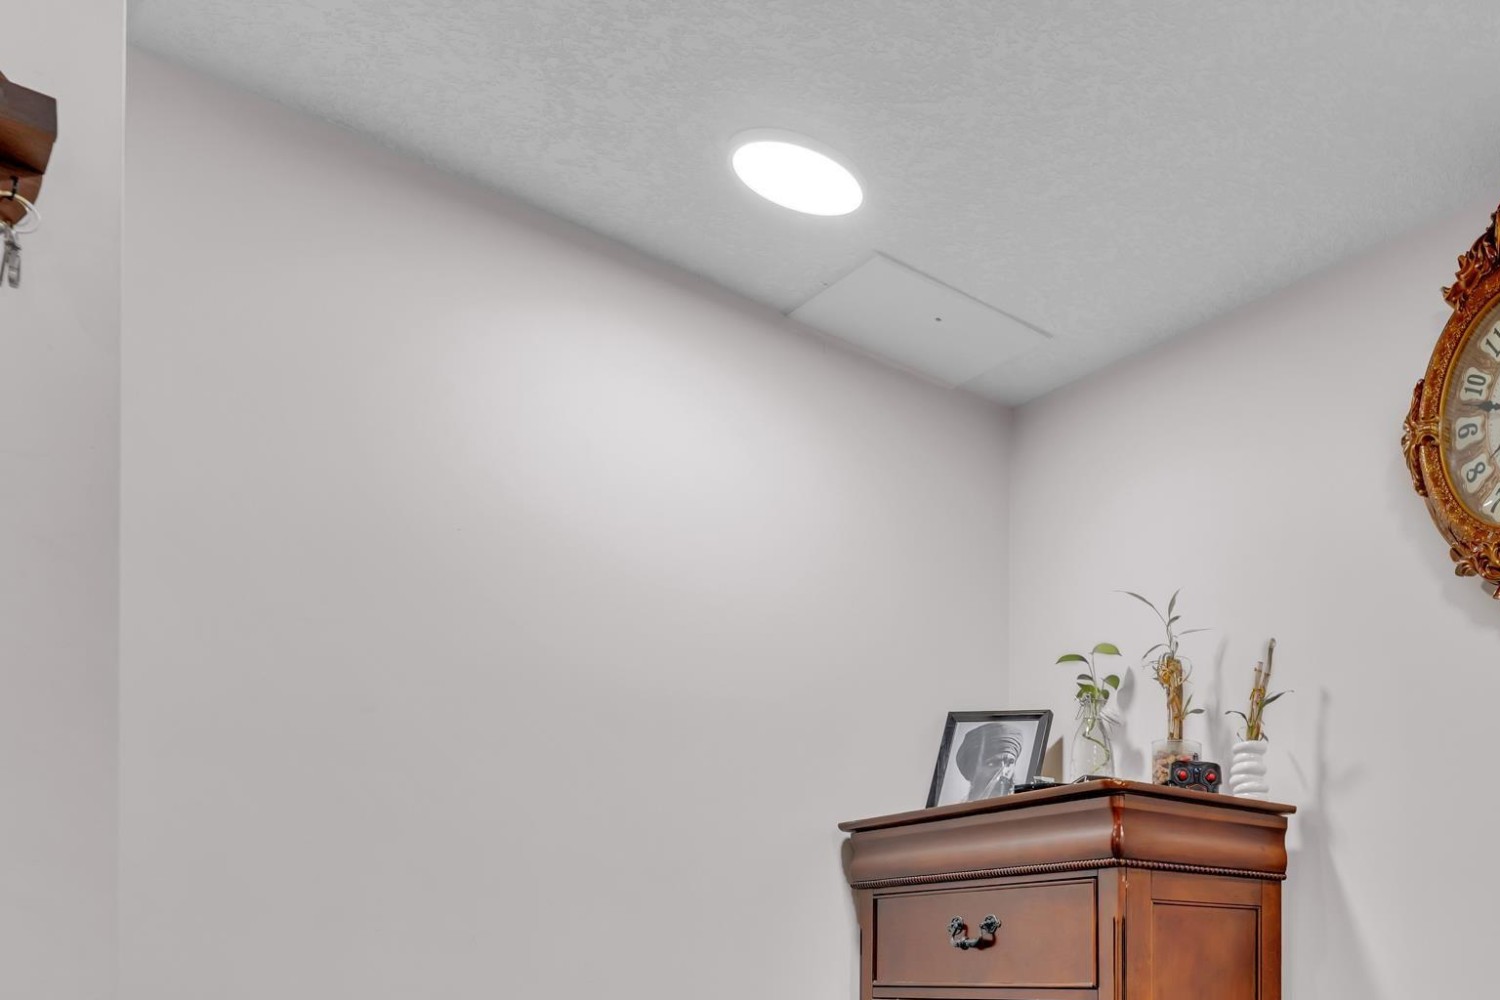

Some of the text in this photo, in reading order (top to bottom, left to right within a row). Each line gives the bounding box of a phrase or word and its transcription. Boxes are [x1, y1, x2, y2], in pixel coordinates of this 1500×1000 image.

[1464, 373, 1487, 397] 10
[1458, 422, 1478, 440] 9
[1466, 462, 1486, 483] 8
